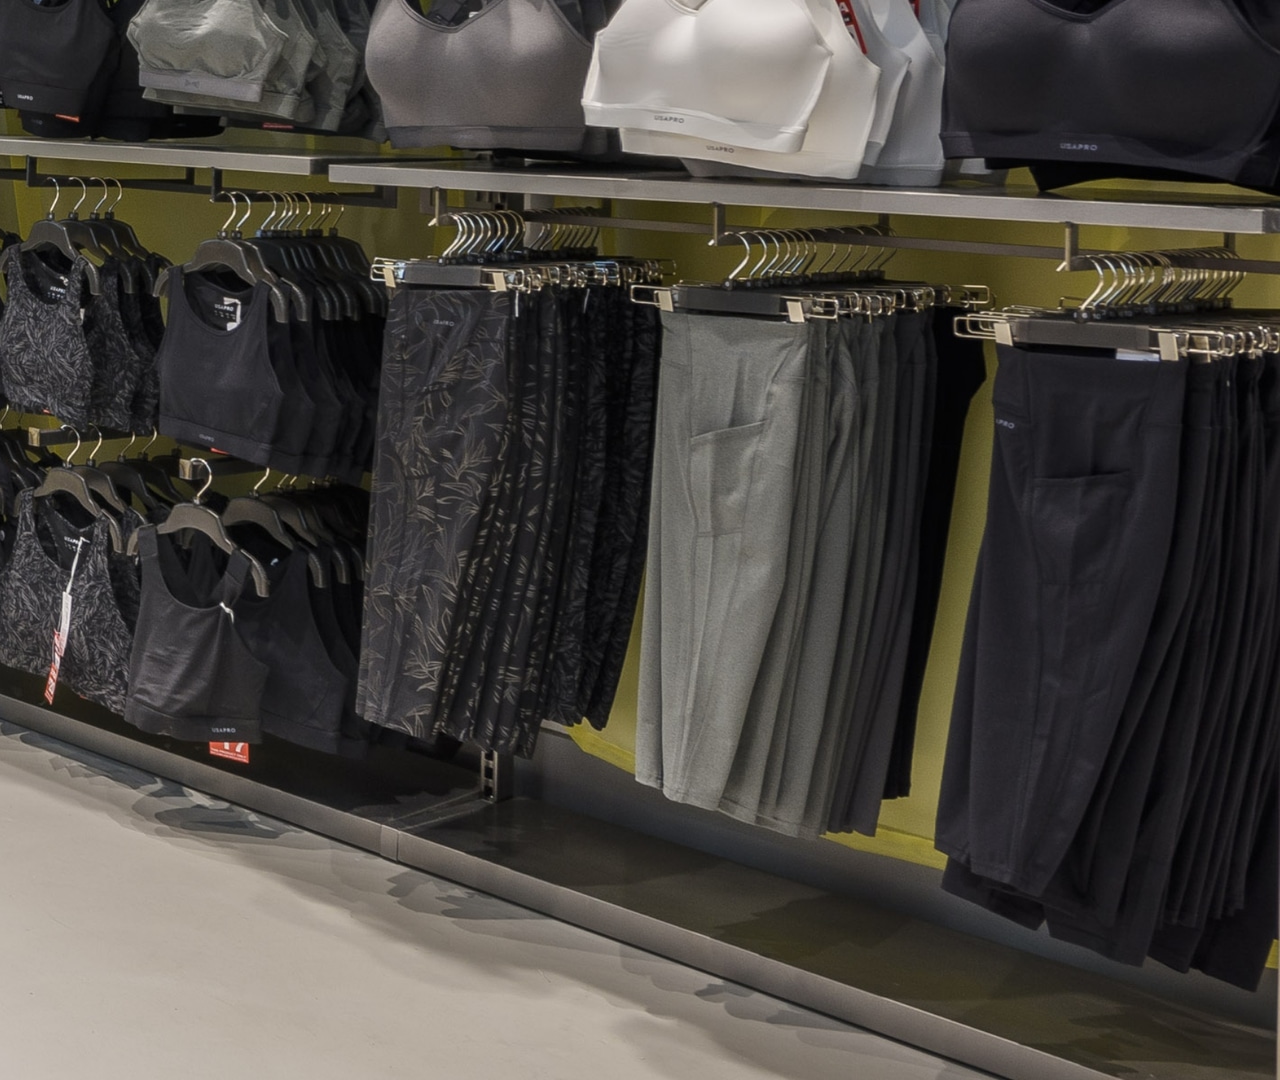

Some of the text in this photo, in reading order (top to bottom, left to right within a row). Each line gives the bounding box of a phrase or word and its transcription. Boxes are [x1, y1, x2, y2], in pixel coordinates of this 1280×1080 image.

[654, 115, 685, 124] USAPRO
[706, 145, 735, 154] USAPRO
[1059, 142, 1098, 152] USAPRO
